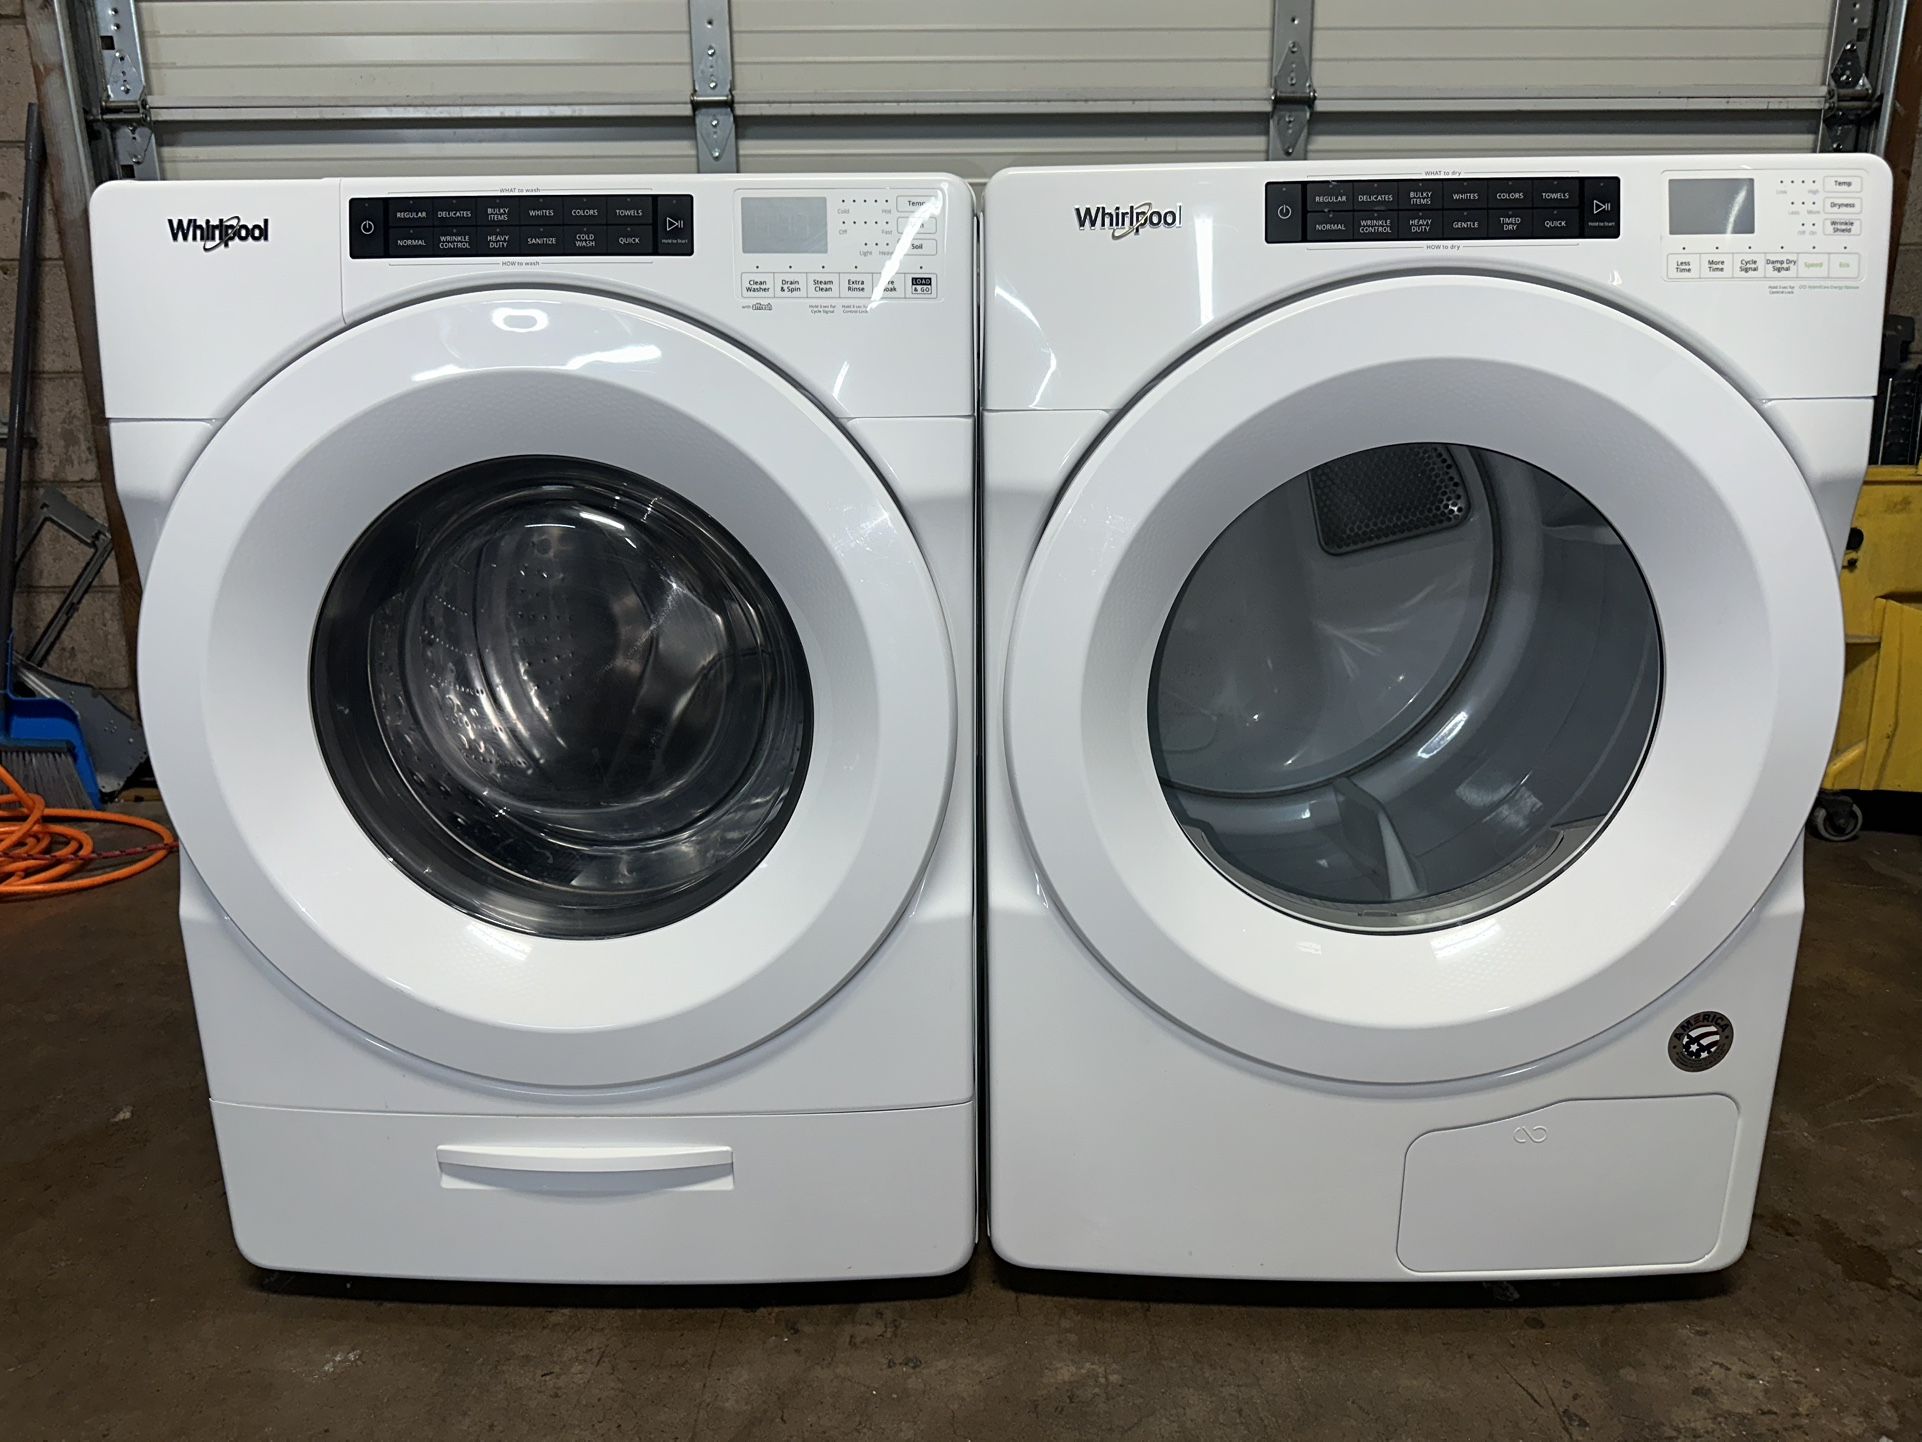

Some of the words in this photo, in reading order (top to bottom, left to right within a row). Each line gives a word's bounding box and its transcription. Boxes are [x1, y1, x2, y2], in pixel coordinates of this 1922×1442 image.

[168, 216, 269, 250] Whirlpool
[1074, 202, 1182, 238] Whirlpool
[1674, 1014, 1729, 1041] AMERICA
